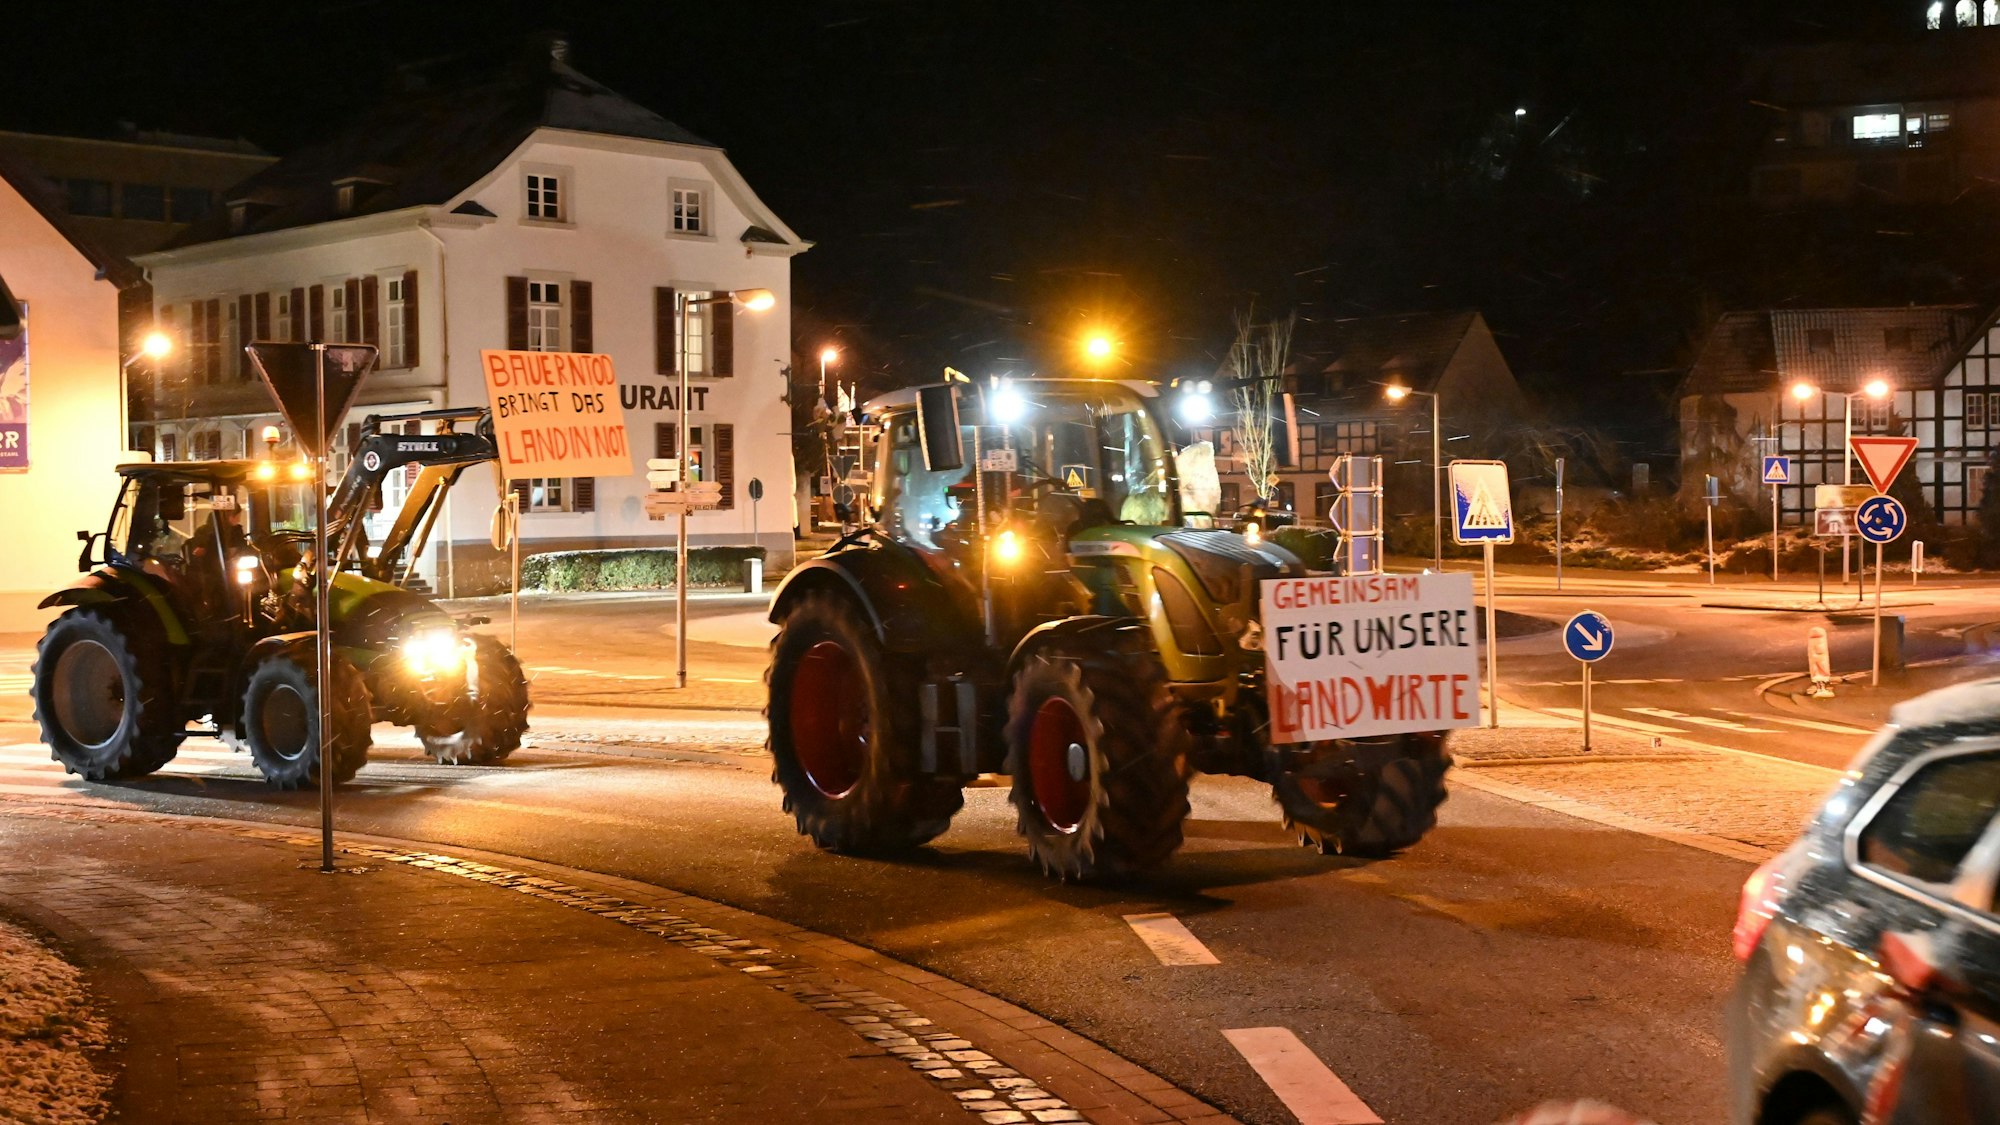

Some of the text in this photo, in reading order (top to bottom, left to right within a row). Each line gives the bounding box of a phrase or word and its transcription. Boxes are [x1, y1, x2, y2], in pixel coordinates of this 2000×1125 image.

[488, 354, 615, 387] BAUERNTOD
[498, 391, 605, 418] BRINGT DAS
[0, 430, 19, 449] R
[593, 425, 627, 458] NOT
[1273, 577, 1420, 609] GEMEINSAM
[1276, 609, 1470, 661] FÜR UNSERE
[1275, 674, 1470, 733] LANDWIRTE
